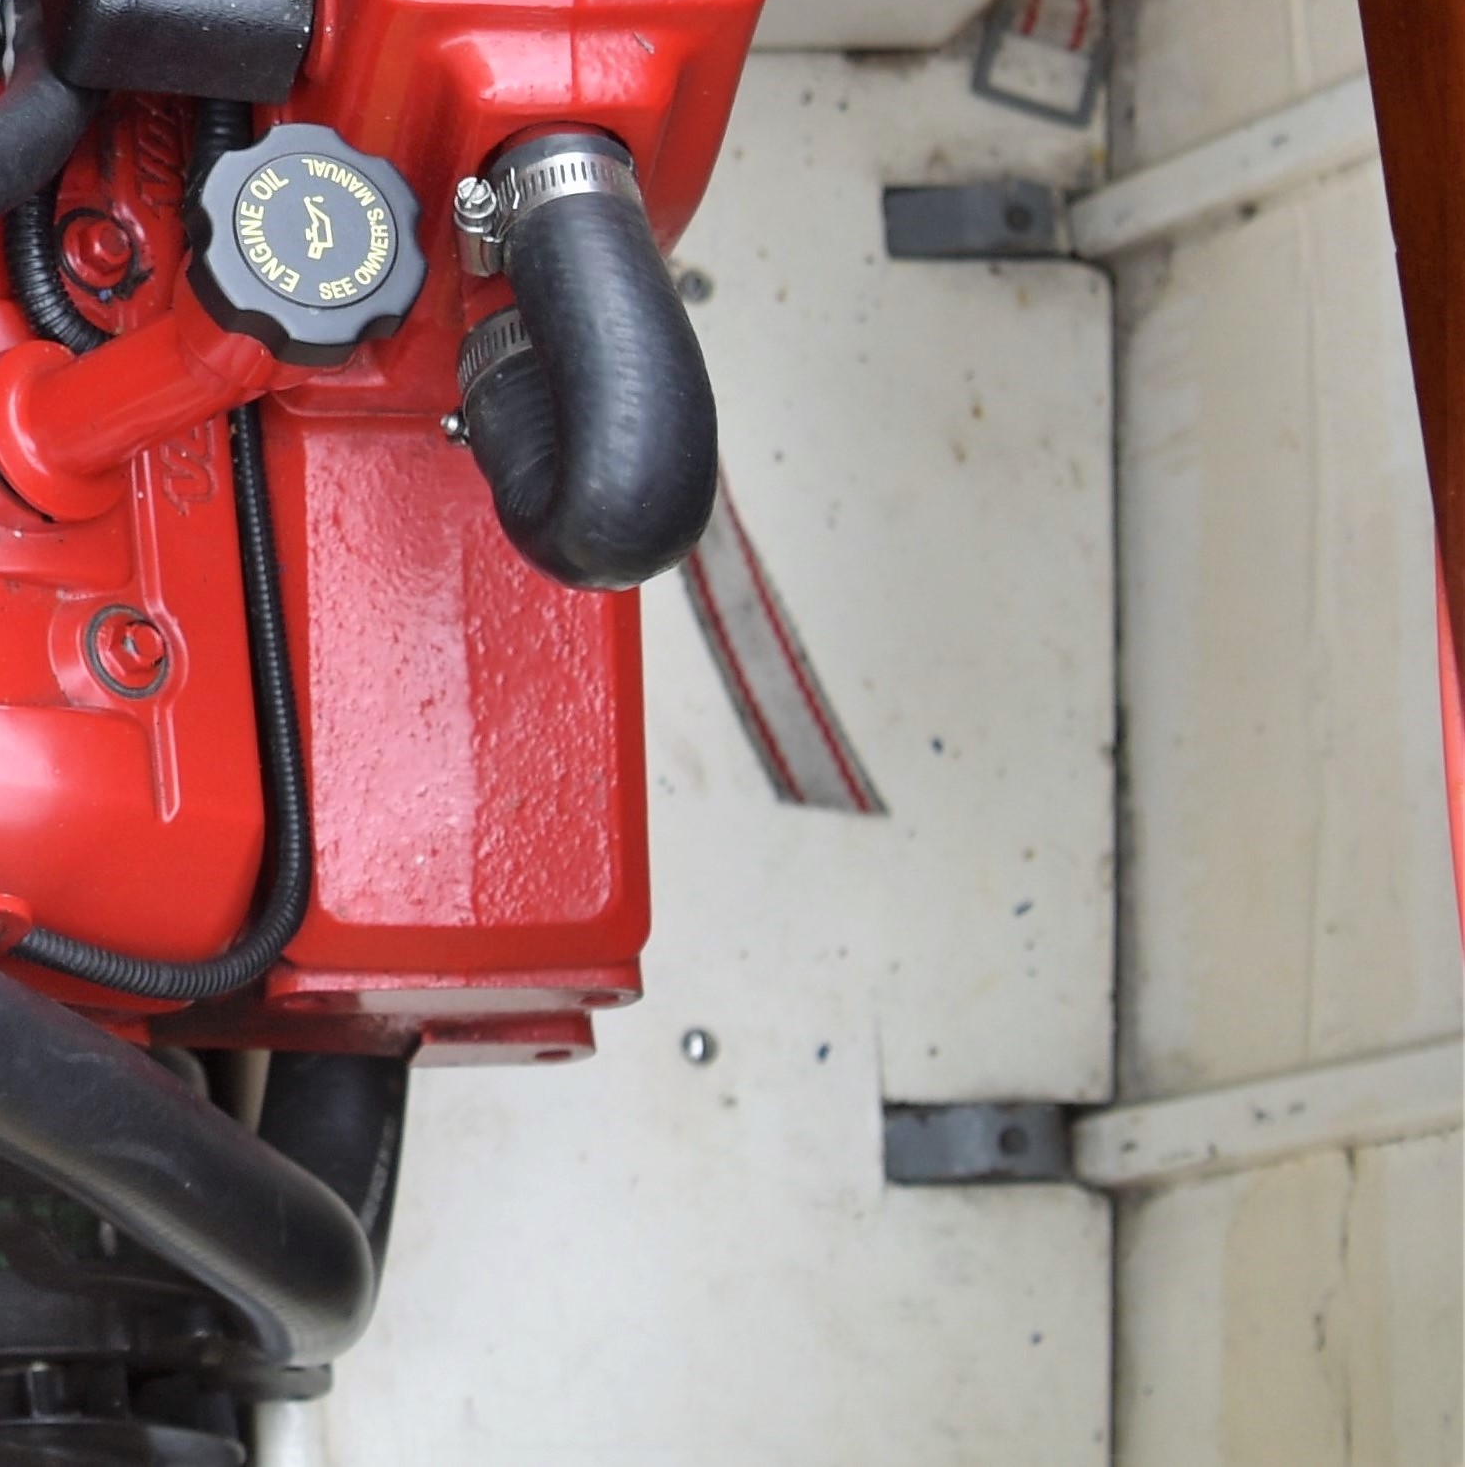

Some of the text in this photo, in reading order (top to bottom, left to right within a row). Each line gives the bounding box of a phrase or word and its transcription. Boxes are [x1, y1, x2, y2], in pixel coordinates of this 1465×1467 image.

[240, 168, 301, 293] ENGINE OIL
[301, 158, 390, 301] SEE OWNER'S MANUAL
